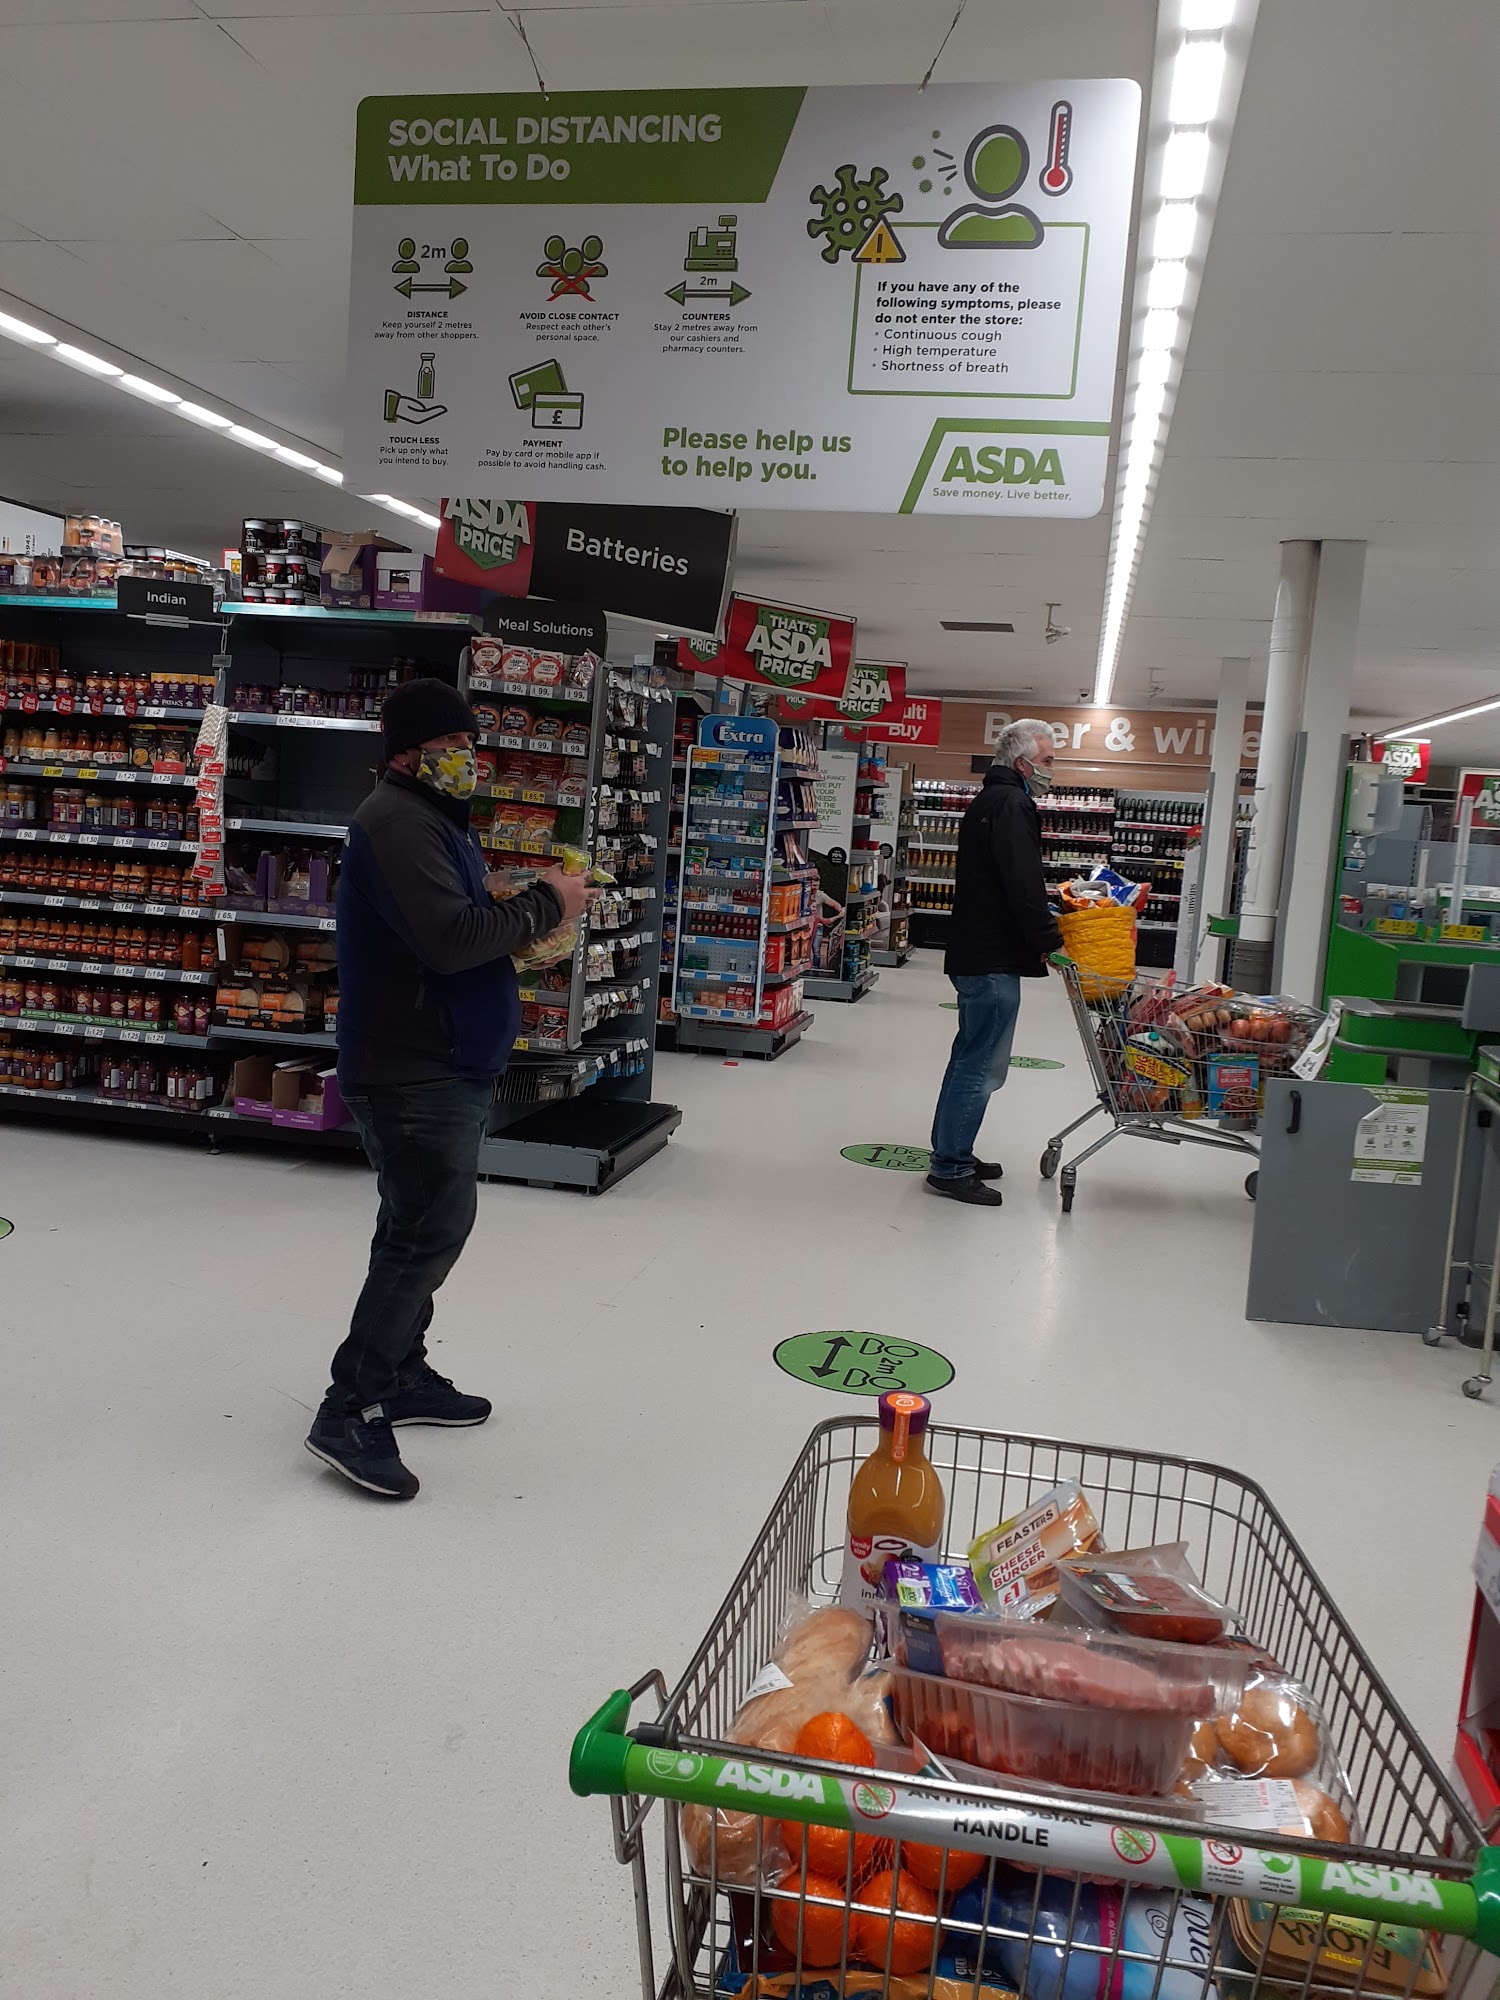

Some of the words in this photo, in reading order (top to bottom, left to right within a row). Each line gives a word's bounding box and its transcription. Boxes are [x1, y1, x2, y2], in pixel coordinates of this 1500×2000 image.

[388, 118, 508, 147] SOCIAL
[516, 113, 722, 145] DISTANCING
[388, 154, 471, 181] What
[480, 154, 517, 181] To
[526, 155, 571, 181] Do
[420, 243, 447, 260] 2m
[700, 276, 718, 286] 2m
[877, 281, 887, 292] If
[891, 282, 914, 293] you
[918, 281, 949, 292] have
[953, 283, 977, 294] any
[981, 282, 996, 292] of
[998, 282, 1020, 293] the
[876, 297, 937, 309] following
[941, 299, 1014, 310] symptoms,
[1017, 299, 1061, 310] please
[407, 311, 449, 319] DISTANCE
[519, 312, 547, 320] AVOID
[578, 313, 620, 321] CONTACT
[682, 313, 731, 321] COUNTERS
[875, 313, 892, 323] do
[895, 314, 917, 324] not
[921, 315, 956, 324] enter
[960, 314, 981, 324] the
[985, 315, 1023, 325] store:
[382, 321, 403, 331] Keep
[404, 321, 437, 331] yourself
[526, 323, 559, 333] Respect
[561, 323, 581, 331] each
[582, 323, 611, 331] other's
[654, 323, 672, 333] Stay
[682, 324, 711, 332] metres
[737, 324, 758, 332] from
[396, 331, 416, 339] from
[417, 331, 438, 339] other
[440, 331, 479, 340] shoppers.
[536, 334, 571, 342] personal
[686, 334, 721, 342] cashiers
[723, 334, 740, 342] and
[884, 328, 957, 340] Continuous
[961, 330, 1002, 342] cough
[662, 344, 704, 354] pharmacy
[706, 345, 746, 353] counters.
[883, 345, 912, 357] High
[916, 346, 997, 357] temperature
[881, 360, 945, 371] Shortness
[949, 361, 963, 371] of
[966, 362, 1009, 373] breath
[389, 436, 418, 444] TOUCH
[523, 440, 563, 448] PAYMENT
[663, 427, 748, 450] Please
[756, 429, 814, 455] help
[822, 435, 852, 453] us
[380, 446, 396, 454] Pick
[398, 448, 408, 456] up
[410, 447, 427, 456] only
[429, 447, 449, 455] what
[486, 449, 500, 458] Pay
[502, 449, 513, 458] by
[515, 449, 533, 457] card
[545, 450, 574, 459] mobile
[575, 452, 592, 461] app
[593, 451, 600, 459] if
[395, 456, 420, 465] intend
[422, 457, 431, 465] to
[432, 457, 448, 466] buy.
[478, 459, 511, 468] possible
[513, 460, 522, 468] to
[523, 460, 547, 469] avoid
[548, 461, 583, 471] handling
[585, 462, 606, 470] cash.
[661, 456, 688, 476] to
[696, 455, 753, 482] help
[761, 461, 817, 483] you.
[941, 446, 1065, 485] ASDA
[932, 487, 959, 497] Save
[962, 490, 1003, 500] money.
[1007, 489, 1030, 499] Live
[1034, 490, 1072, 501] better.
[443, 498, 531, 545] ASDA
[459, 525, 513, 561] PRICE
[566, 528, 690, 576] Batteries
[146, 590, 187, 606] Indian
[499, 617, 529, 632] Meal
[533, 620, 594, 637] Solutions
[770, 615, 817, 635] THAT'S
[689, 637, 718, 656] PRICE
[745, 624, 832, 668] ASDA
[759, 655, 814, 680] PRICE
[846, 678, 892, 702] SDA
[839, 700, 880, 713] PRICE
[903, 703, 927, 720] ulti
[719, 725, 764, 744] Extra
[888, 725, 922, 740] Buy
[984, 711, 1091, 749] Ber
[1104, 716, 1136, 752] &
[1381, 750, 1422, 769] ASDA
[876, 1357, 904, 1375] 2m
[996, 1509, 1054, 1554] FEASTERS
[991, 1541, 1041, 1578] CHEESE
[994, 1550, 1046, 1589] BURGER
[1003, 1582, 1020, 1605] £1
[715, 1761, 825, 1804] ASDA
[953, 1817, 1049, 1847] HANDLE
[1321, 1861, 1444, 1910] ASDA
[1278, 1920, 1392, 1970] FLORA
